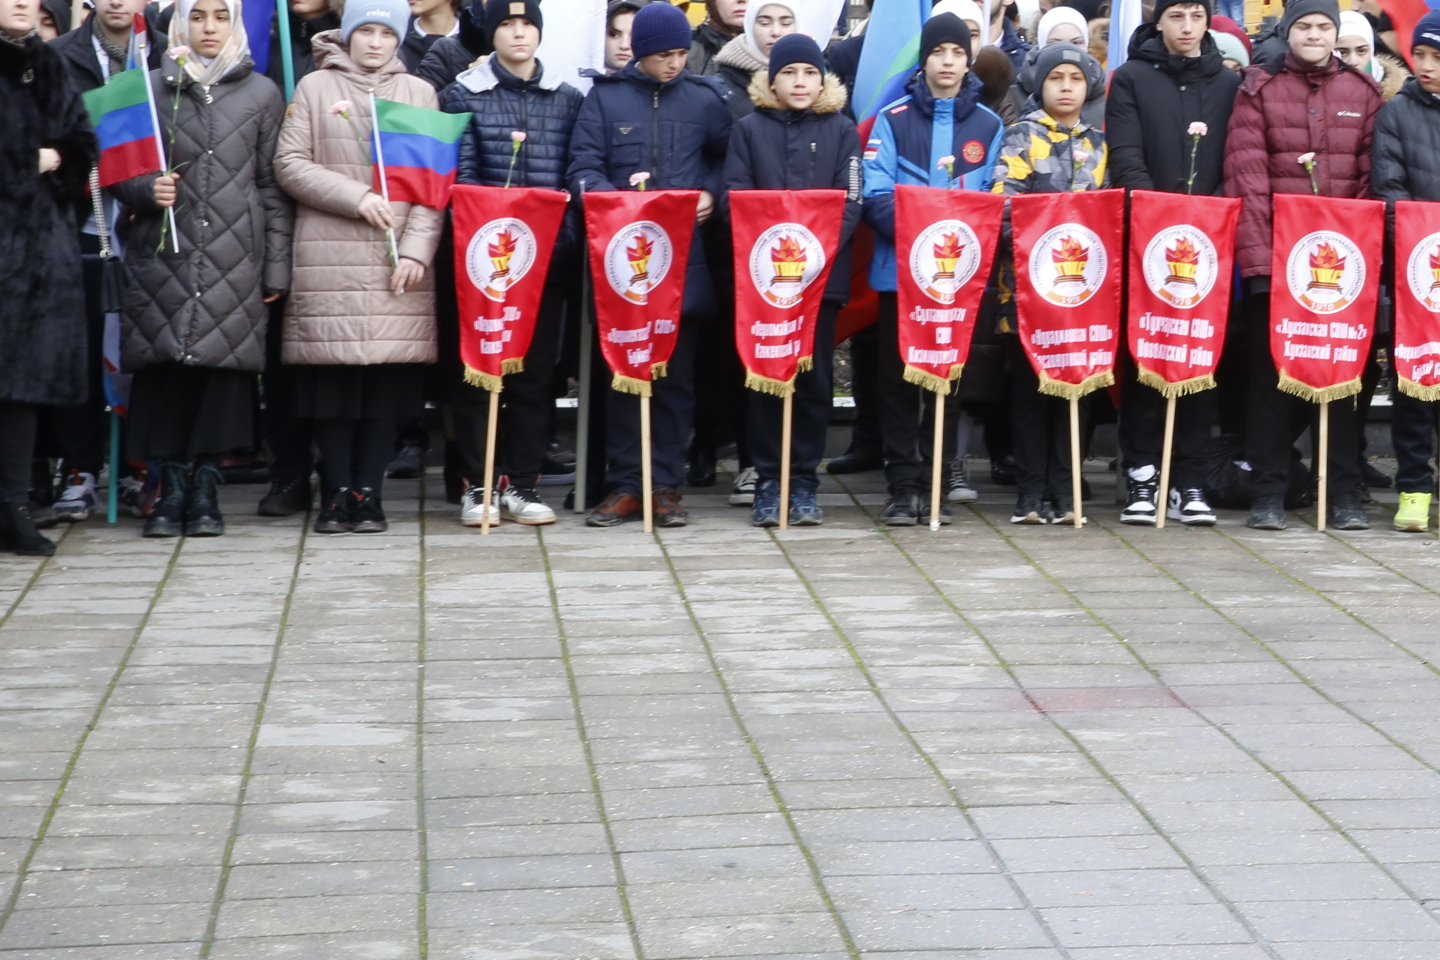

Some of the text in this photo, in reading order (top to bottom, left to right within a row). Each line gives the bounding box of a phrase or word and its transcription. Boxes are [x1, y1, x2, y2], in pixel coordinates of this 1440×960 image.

[1310, 267, 1343, 283] ТОКС
[1311, 301, 1335, 311] 1970
[1089, 324, 1113, 342] СОШ»
[1190, 318, 1214, 339] СОШ»
[1275, 317, 1328, 338] «Хунзахская
[1189, 346, 1214, 369] район
[1283, 340, 1358, 365] Хунзахский район
